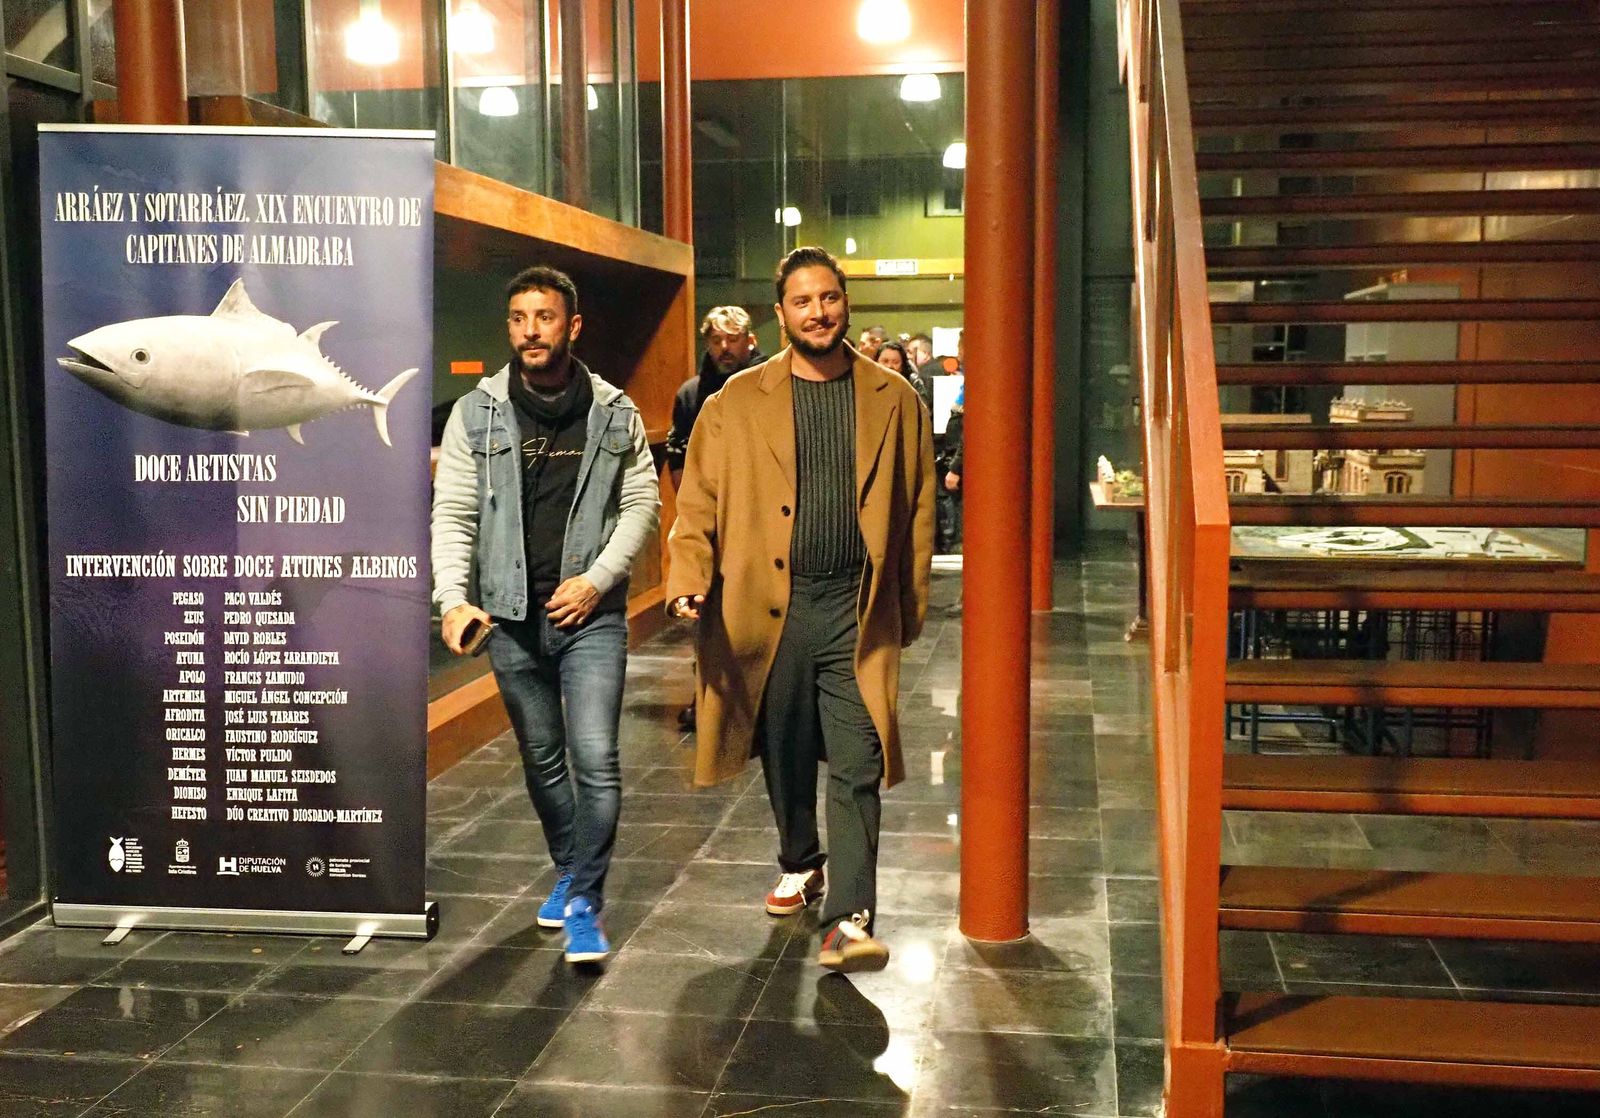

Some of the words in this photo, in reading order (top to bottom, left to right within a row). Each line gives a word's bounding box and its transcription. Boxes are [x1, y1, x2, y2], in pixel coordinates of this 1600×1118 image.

[55, 185, 124, 222] ARRÁEZ
[128, 193, 140, 222] Y
[145, 187, 250, 223] SOTARRÁEZ.
[255, 194, 287, 223] XIX
[293, 195, 394, 226] ENCUENTRO
[399, 197, 421, 227] DE
[126, 235, 217, 264] CAPITANES
[222, 235, 244, 264] DE
[249, 236, 354, 266] ALMADRABA
[135, 455, 181, 482] DOCE
[186, 455, 276, 482] ARTISTAS
[237, 496, 268, 523] SIN
[275, 497, 345, 523] PIEDAD
[66, 550, 175, 577] INTERVENCIÓN
[183, 555, 227, 578] SOBRE
[234, 556, 273, 578] DOCE
[281, 556, 341, 578] ATUNES
[351, 556, 417, 578] ALBINOS
[173, 592, 203, 605] PEGASO
[225, 592, 245, 605] PACO
[249, 590, 281, 605] VALDÉS
[184, 611, 203, 624] ZEUS
[224, 612, 251, 624] PEDRO
[256, 612, 295, 625] QUESADA
[164, 630, 204, 644] POSEIDÓN
[224, 632, 249, 644] DAVID
[253, 632, 286, 645] ROBLES
[176, 652, 204, 664] ATUNA
[224, 649, 249, 664] ROCÍO
[253, 649, 280, 664] LÓPEZ
[284, 652, 339, 665] ZARANDIETA
[179, 671, 205, 683] APOLO
[224, 671, 261, 684] FRANCIS
[266, 672, 304, 684] ZAMUDIO
[163, 690, 205, 702] ARTEMISA
[225, 691, 257, 703] MIGUEL
[261, 688, 290, 704] ÁNGEL
[294, 688, 347, 704] CONCEPCIÓN
[165, 709, 205, 721] AFRODITA
[225, 709, 243, 725] JOSÉ
[248, 711, 267, 723] LUIS
[271, 711, 309, 723] TABARES
[166, 728, 205, 741] ORICALCO
[225, 730, 266, 743] FAUSTINO
[271, 728, 318, 743] RODRÍGUEZ
[172, 748, 205, 760] HERMES
[226, 747, 256, 761] VÍCTOR
[260, 749, 292, 762] PULIDO
[168, 766, 206, 781] DEMÉTER
[226, 769, 247, 784] JUAN
[251, 770, 287, 783] MANUEL
[292, 770, 336, 783] SEISDEDOS
[174, 787, 206, 800] DIONISO
[227, 788, 262, 802] ENRIQUE
[266, 788, 297, 801] LAFITA
[172, 807, 206, 819] HEFESTO
[227, 807, 243, 821] DÚO
[247, 808, 289, 821] CREATIVO
[293, 807, 382, 822] DIOSDADO-MARTÍNEZ
[239, 857, 286, 865] DIPUTACIÓN
